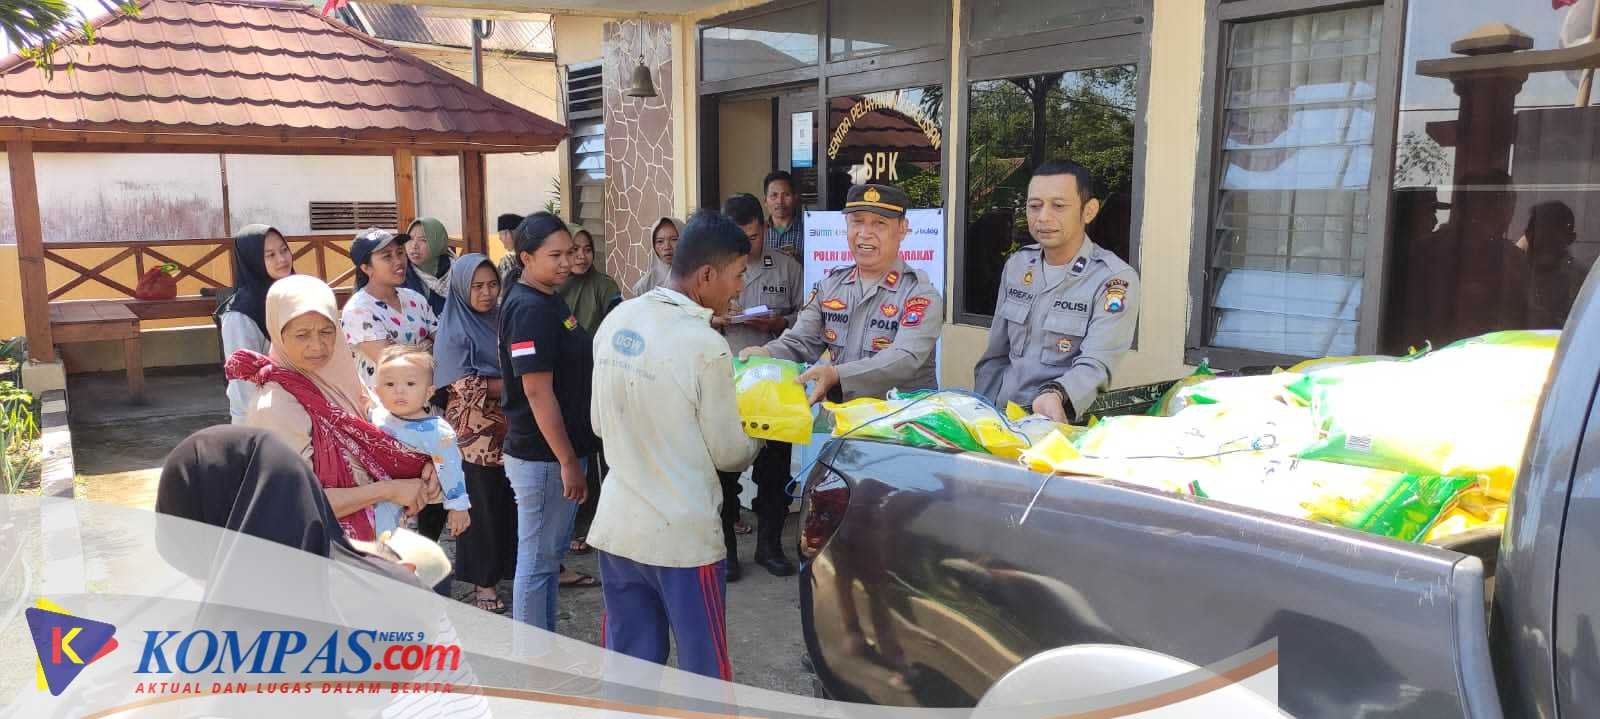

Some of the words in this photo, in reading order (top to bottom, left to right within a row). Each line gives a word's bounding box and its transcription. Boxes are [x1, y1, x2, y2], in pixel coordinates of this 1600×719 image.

[828, 117, 851, 160] SENTRA
[864, 152, 899, 181] SPK
[814, 251, 838, 261] POLRI
[1053, 300, 1088, 313] POLISI
[870, 319, 898, 331] POLR
